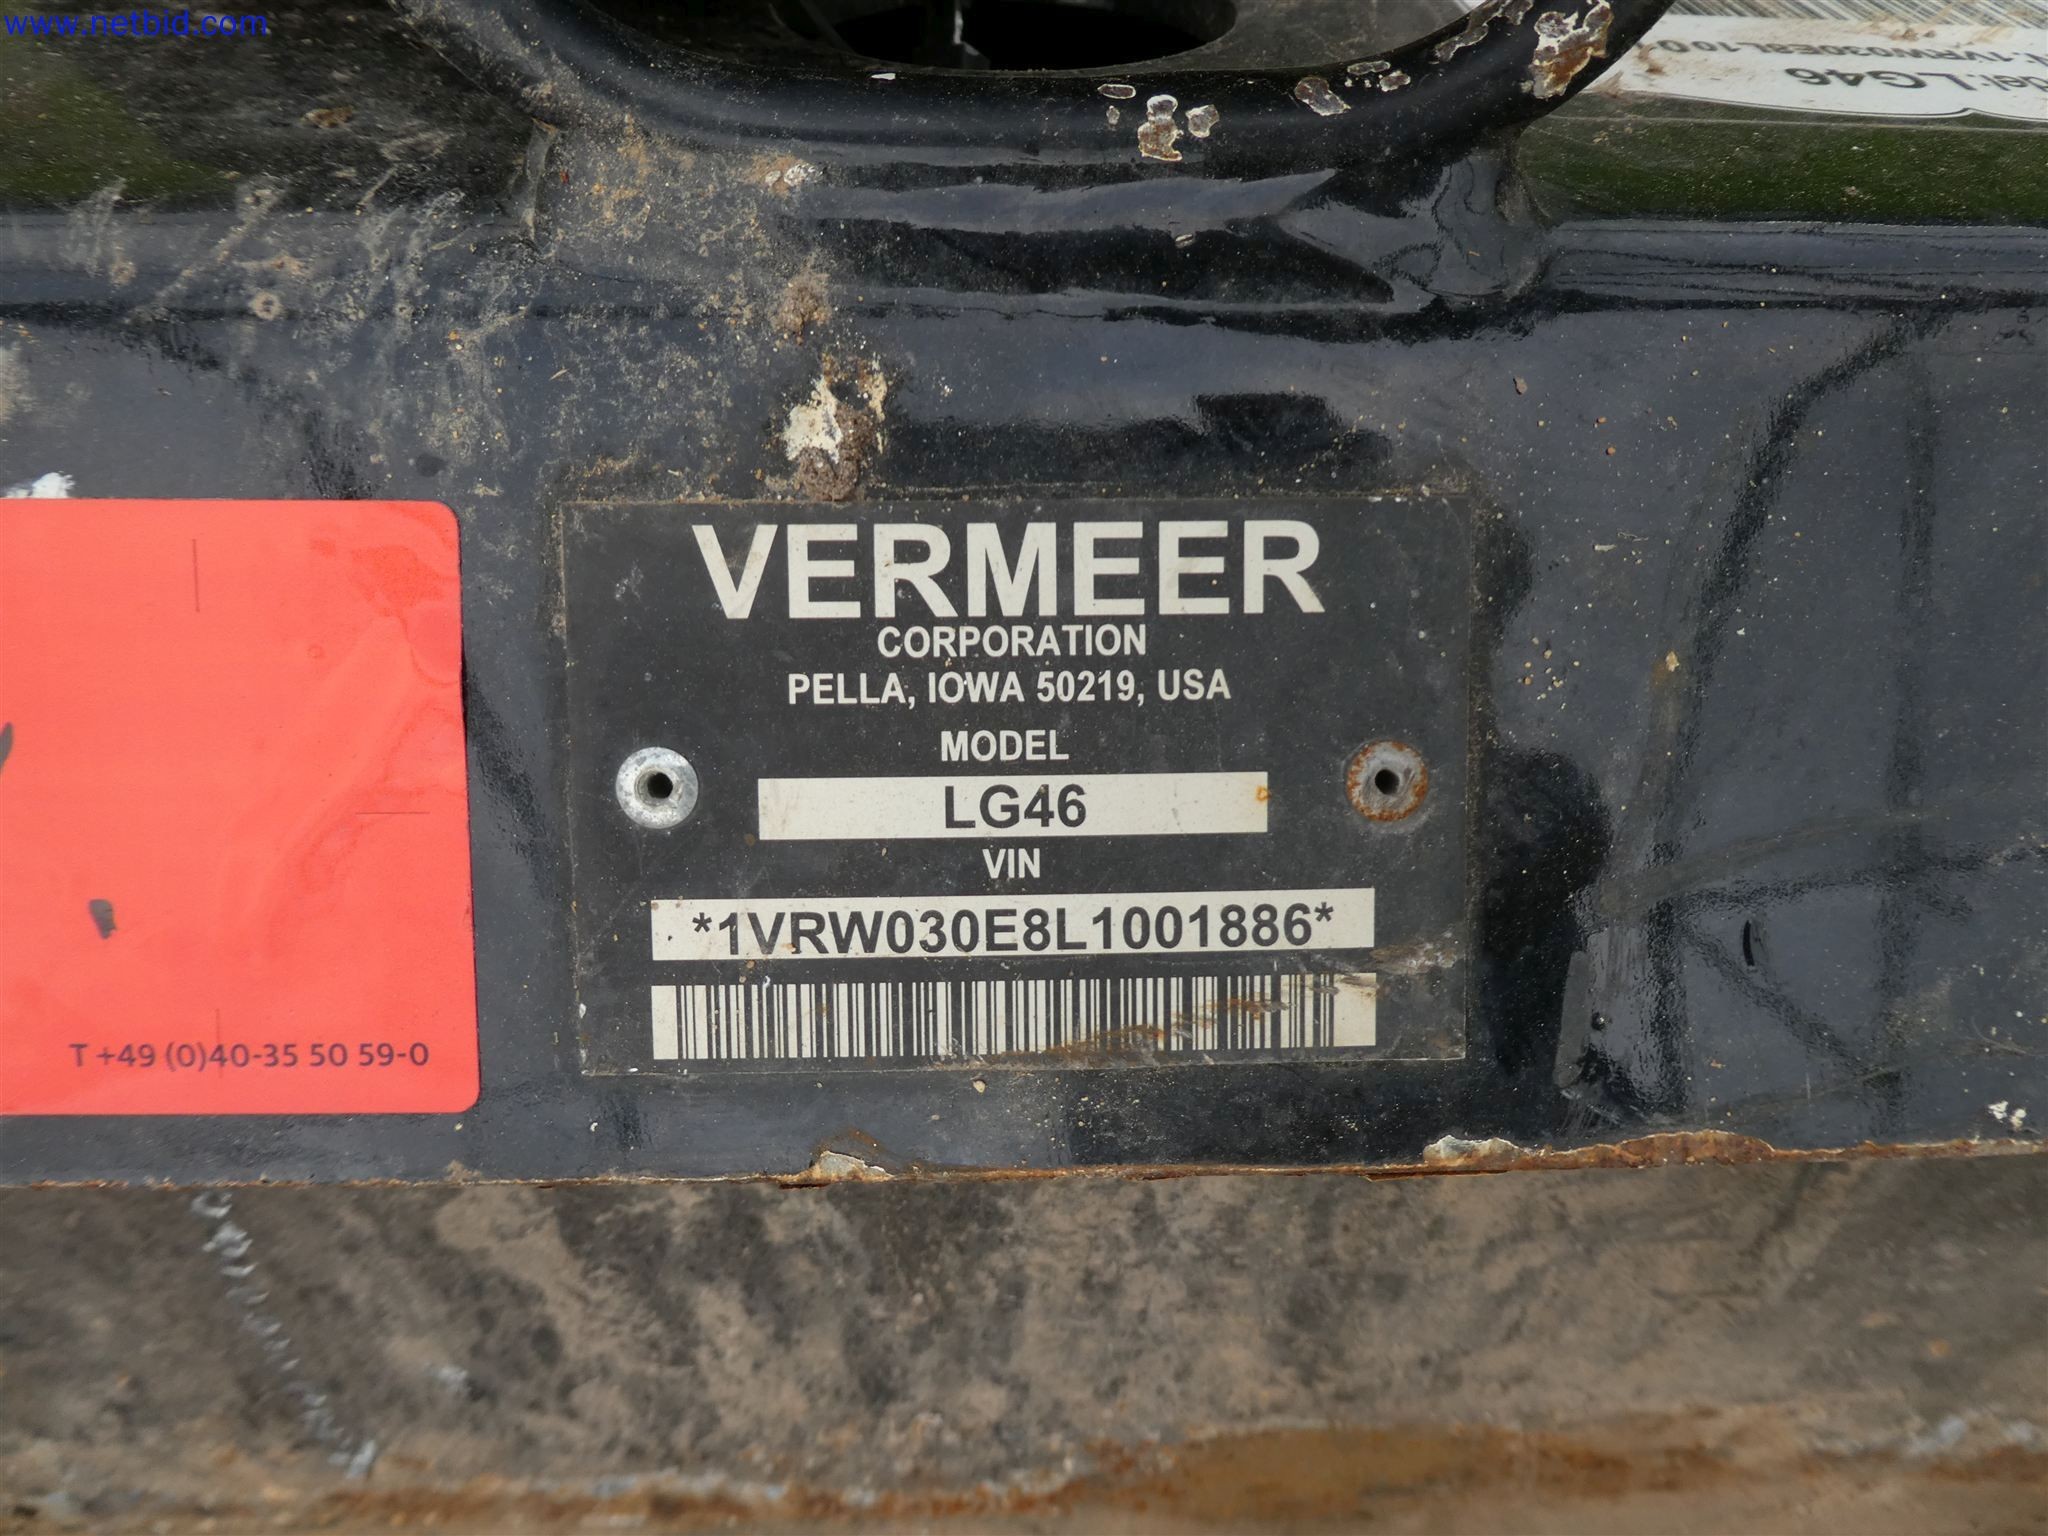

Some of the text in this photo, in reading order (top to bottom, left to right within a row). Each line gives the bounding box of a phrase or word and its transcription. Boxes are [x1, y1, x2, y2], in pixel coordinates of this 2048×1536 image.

[691, 519, 1326, 620] VERMEER
[876, 624, 1148, 659] CORPORATION
[786, 667, 1232, 709] PELLA, IOWA 50219, USA
[939, 729, 1070, 762] MODEL
[943, 784, 1087, 830] LG46
[981, 847, 1041, 880] VIN
[68, 1041, 430, 1073] T +49 (0)40-35 50 59-0
